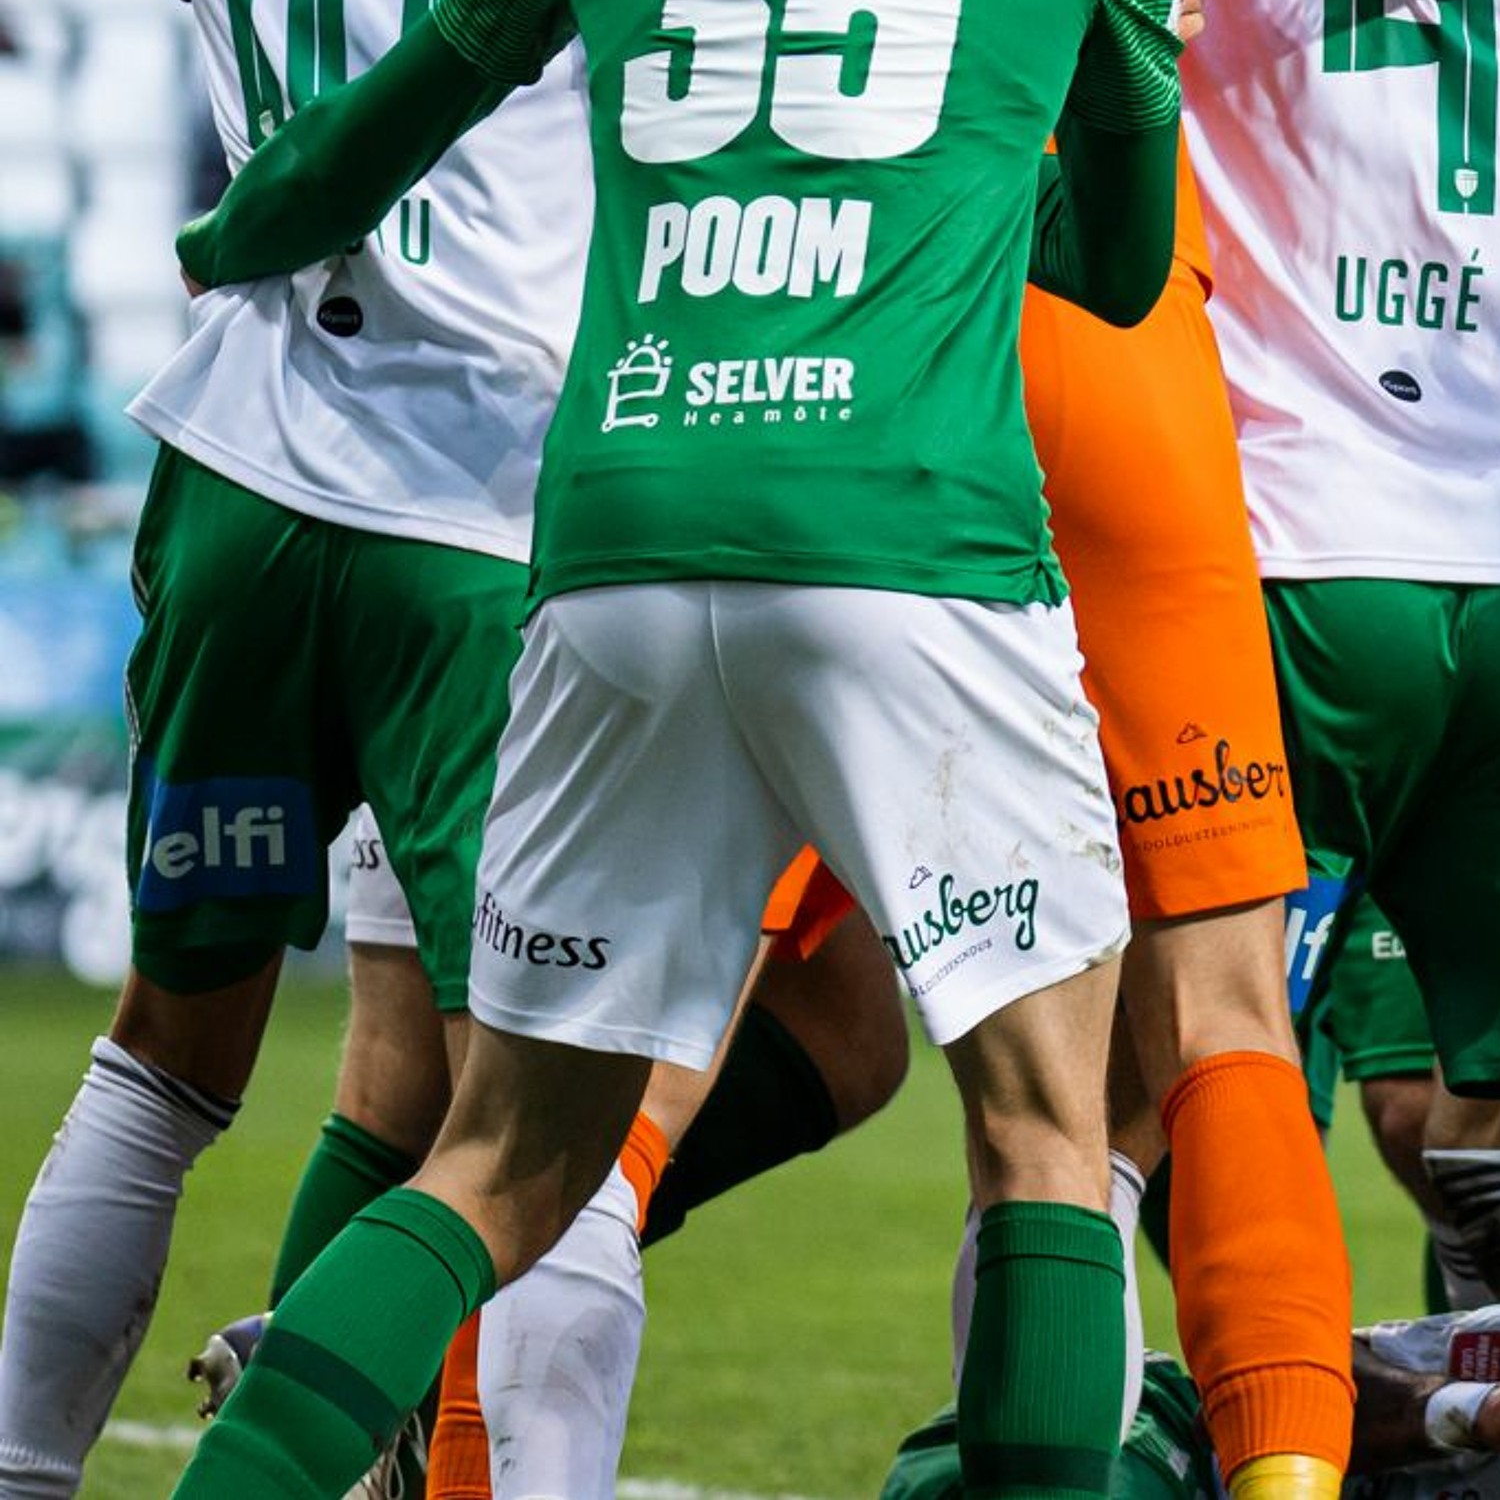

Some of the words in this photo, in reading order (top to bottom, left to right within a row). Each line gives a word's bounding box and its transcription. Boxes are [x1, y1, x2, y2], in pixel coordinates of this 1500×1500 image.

[637, 195, 873, 304] POOM
[1335, 248, 1484, 332] UGGÉ
[683, 410, 745, 426] Hea
[685, 356, 855, 406] SELVER
[1124, 739, 1284, 823] ausber
[151, 806, 286, 879] elfi
